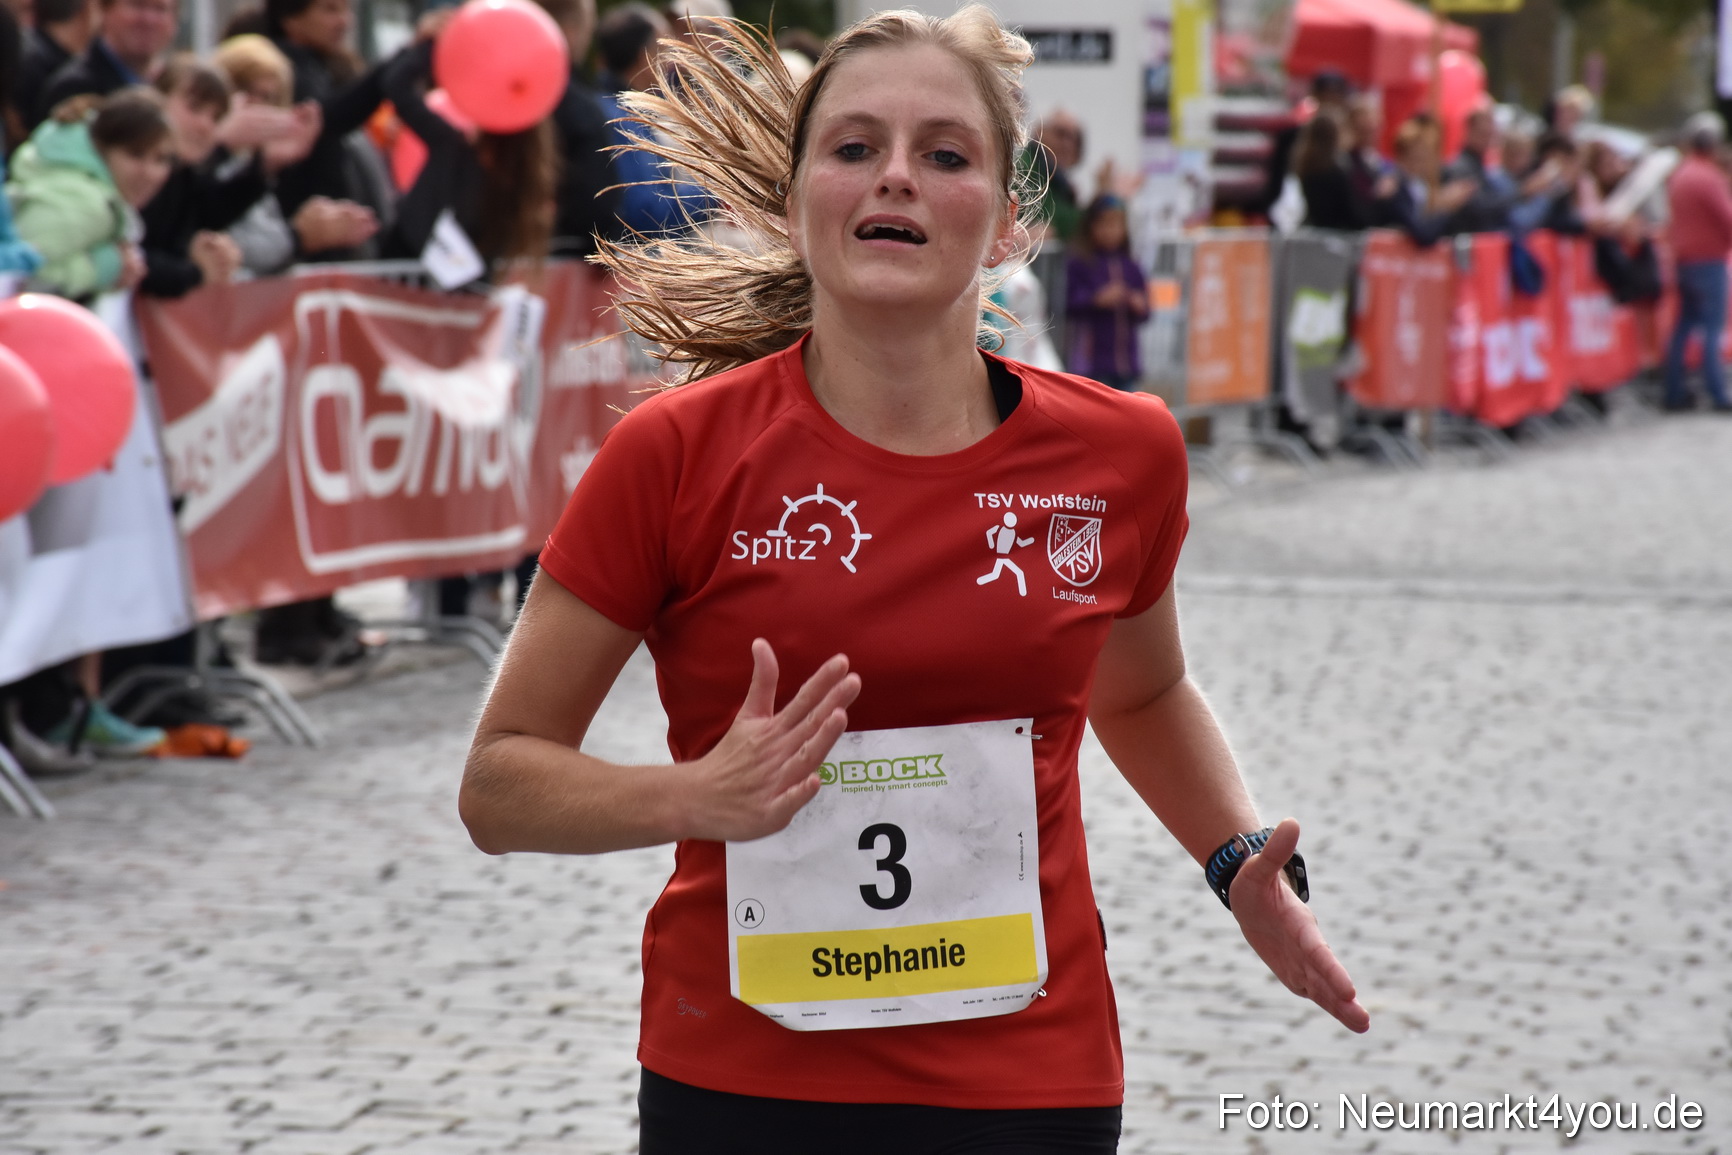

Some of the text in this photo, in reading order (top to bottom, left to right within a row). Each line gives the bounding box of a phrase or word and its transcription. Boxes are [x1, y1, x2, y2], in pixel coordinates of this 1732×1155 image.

[974, 493, 1107, 513] TSV Wolfstein
[731, 529, 817, 566] Spitz
[1052, 534, 1083, 568] WOLFSTEIN
[1065, 535, 1097, 581] TSV
[1052, 585, 1098, 606] Laufsport
[839, 753, 947, 785] BOCK
[841, 778, 949, 795] inspired by smart concepts
[857, 822, 913, 911] 3
[743, 906, 756, 923] A
[811, 937, 966, 982] Stephanie
